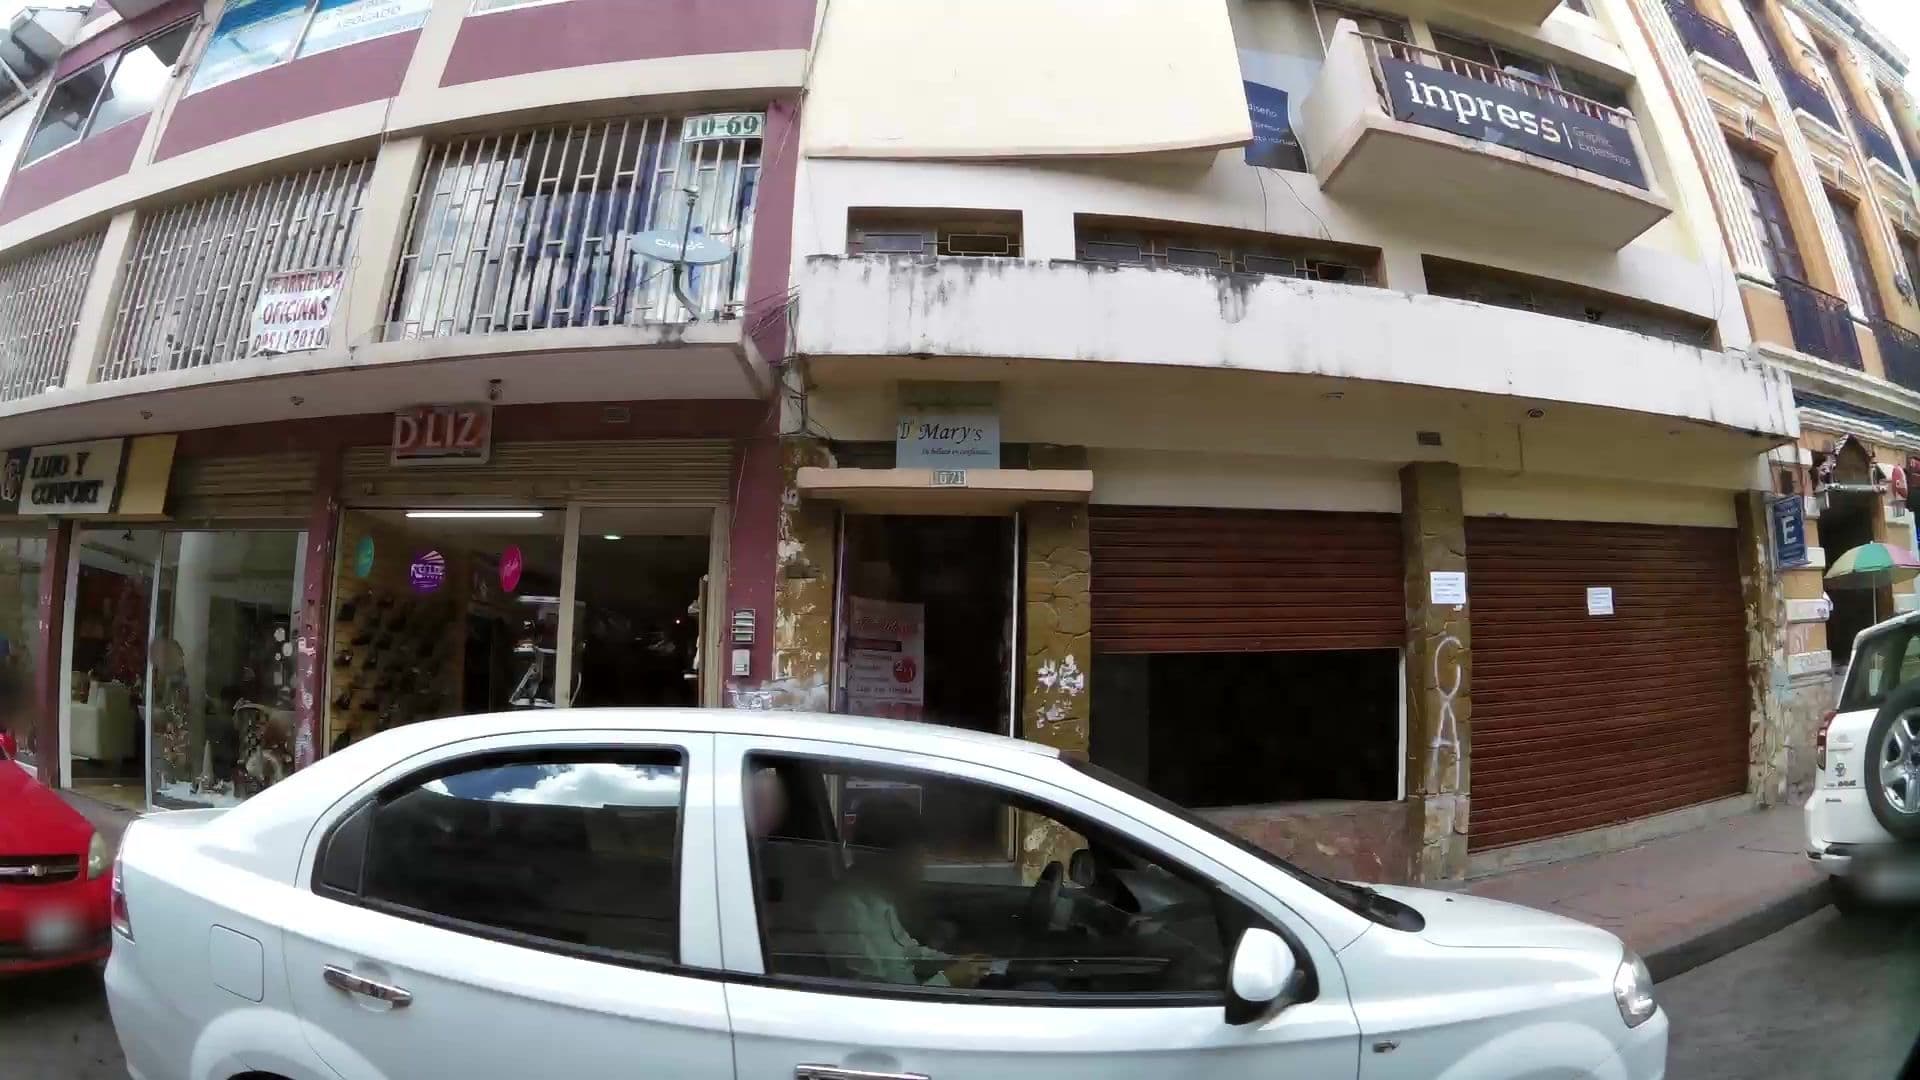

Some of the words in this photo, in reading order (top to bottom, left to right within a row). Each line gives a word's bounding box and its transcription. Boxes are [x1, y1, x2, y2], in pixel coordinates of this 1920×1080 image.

[1404, 71, 1560, 142] inpress
[690, 115, 758, 137] 10-69
[263, 295, 330, 325] OFICINAS
[393, 410, 476, 448] D'LIZ
[918, 422, 984, 445] Mary's
[76, 452, 91, 476] Y
[1782, 516, 1797, 545] E
